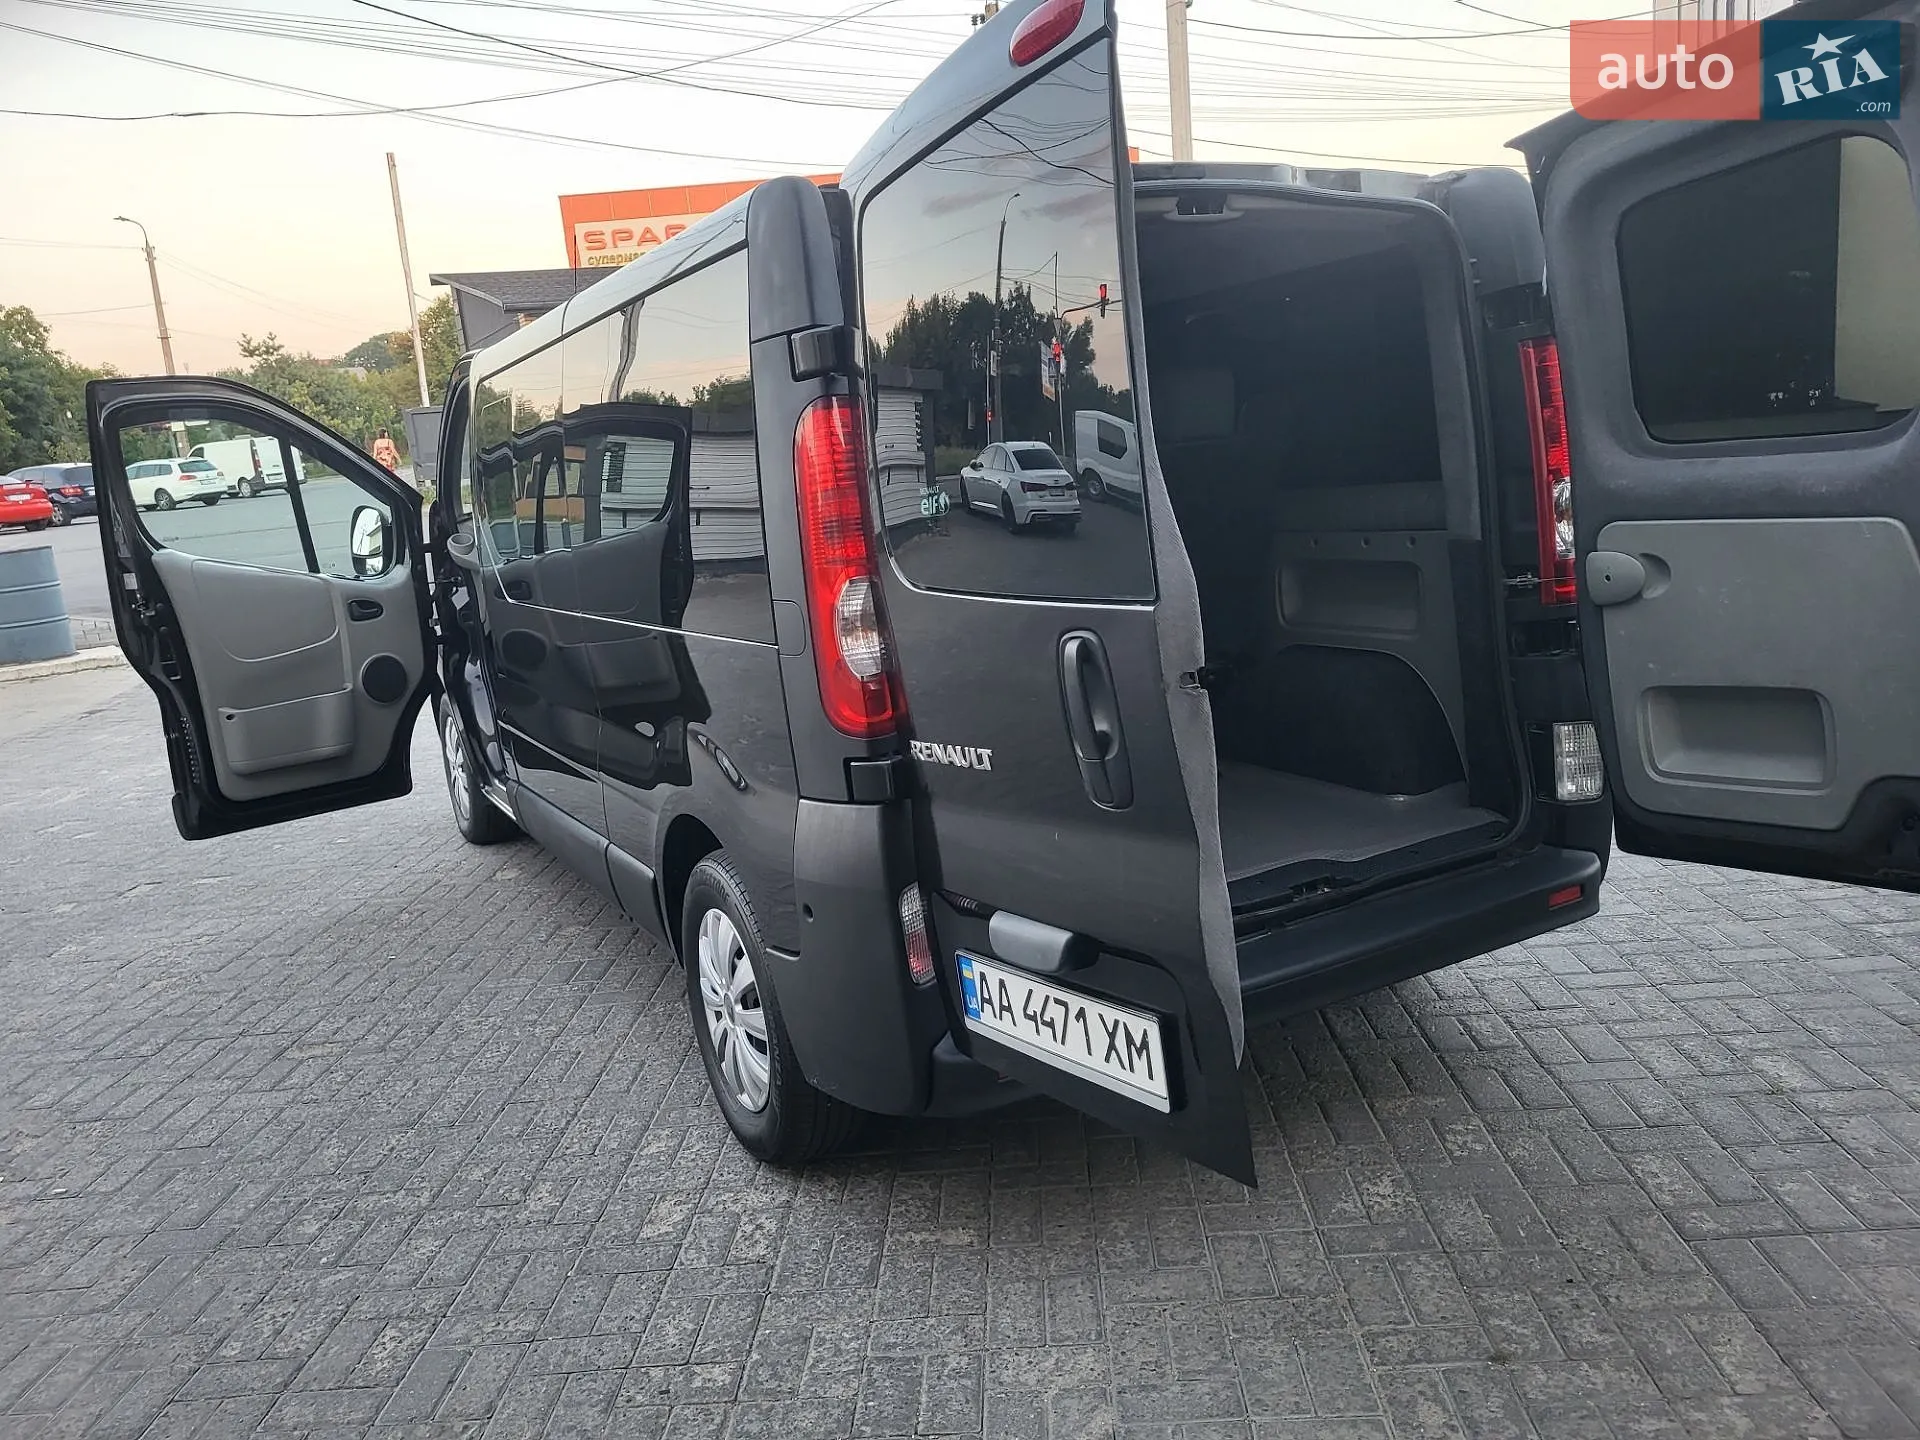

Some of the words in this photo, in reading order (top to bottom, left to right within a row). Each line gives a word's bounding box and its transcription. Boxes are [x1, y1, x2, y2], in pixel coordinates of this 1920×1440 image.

[909, 740, 993, 771] RENAULT
[979, 970, 1018, 1028] AA
[1022, 988, 1093, 1057] 4471
[1098, 1012, 1155, 1081] XM
